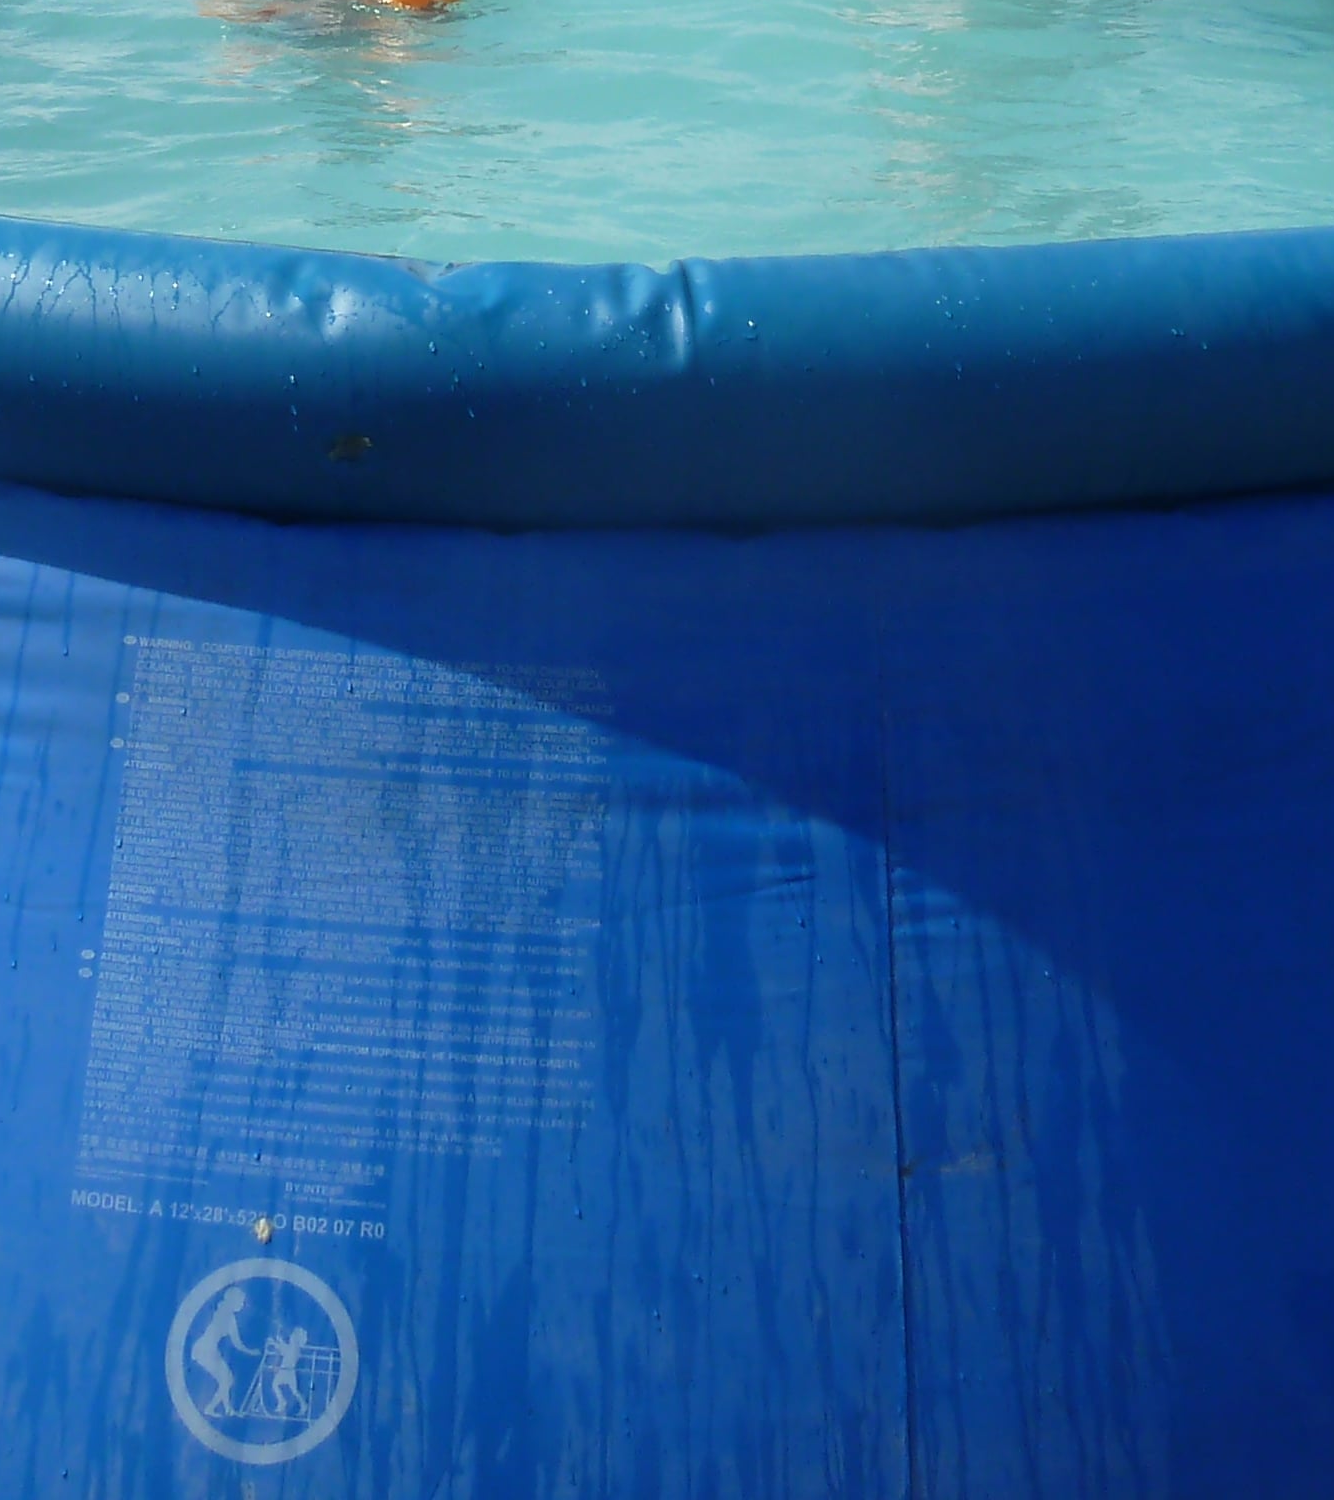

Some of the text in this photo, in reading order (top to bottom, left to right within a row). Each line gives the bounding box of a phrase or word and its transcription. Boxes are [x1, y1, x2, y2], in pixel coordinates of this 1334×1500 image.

[285, 1181, 300, 1192] BY
[71, 1188, 143, 1214] MODEL:
[149, 1203, 163, 1218] A
[293, 1215, 327, 1234] B02
[333, 1219, 354, 1235] 07
[360, 1221, 385, 1239] R0
